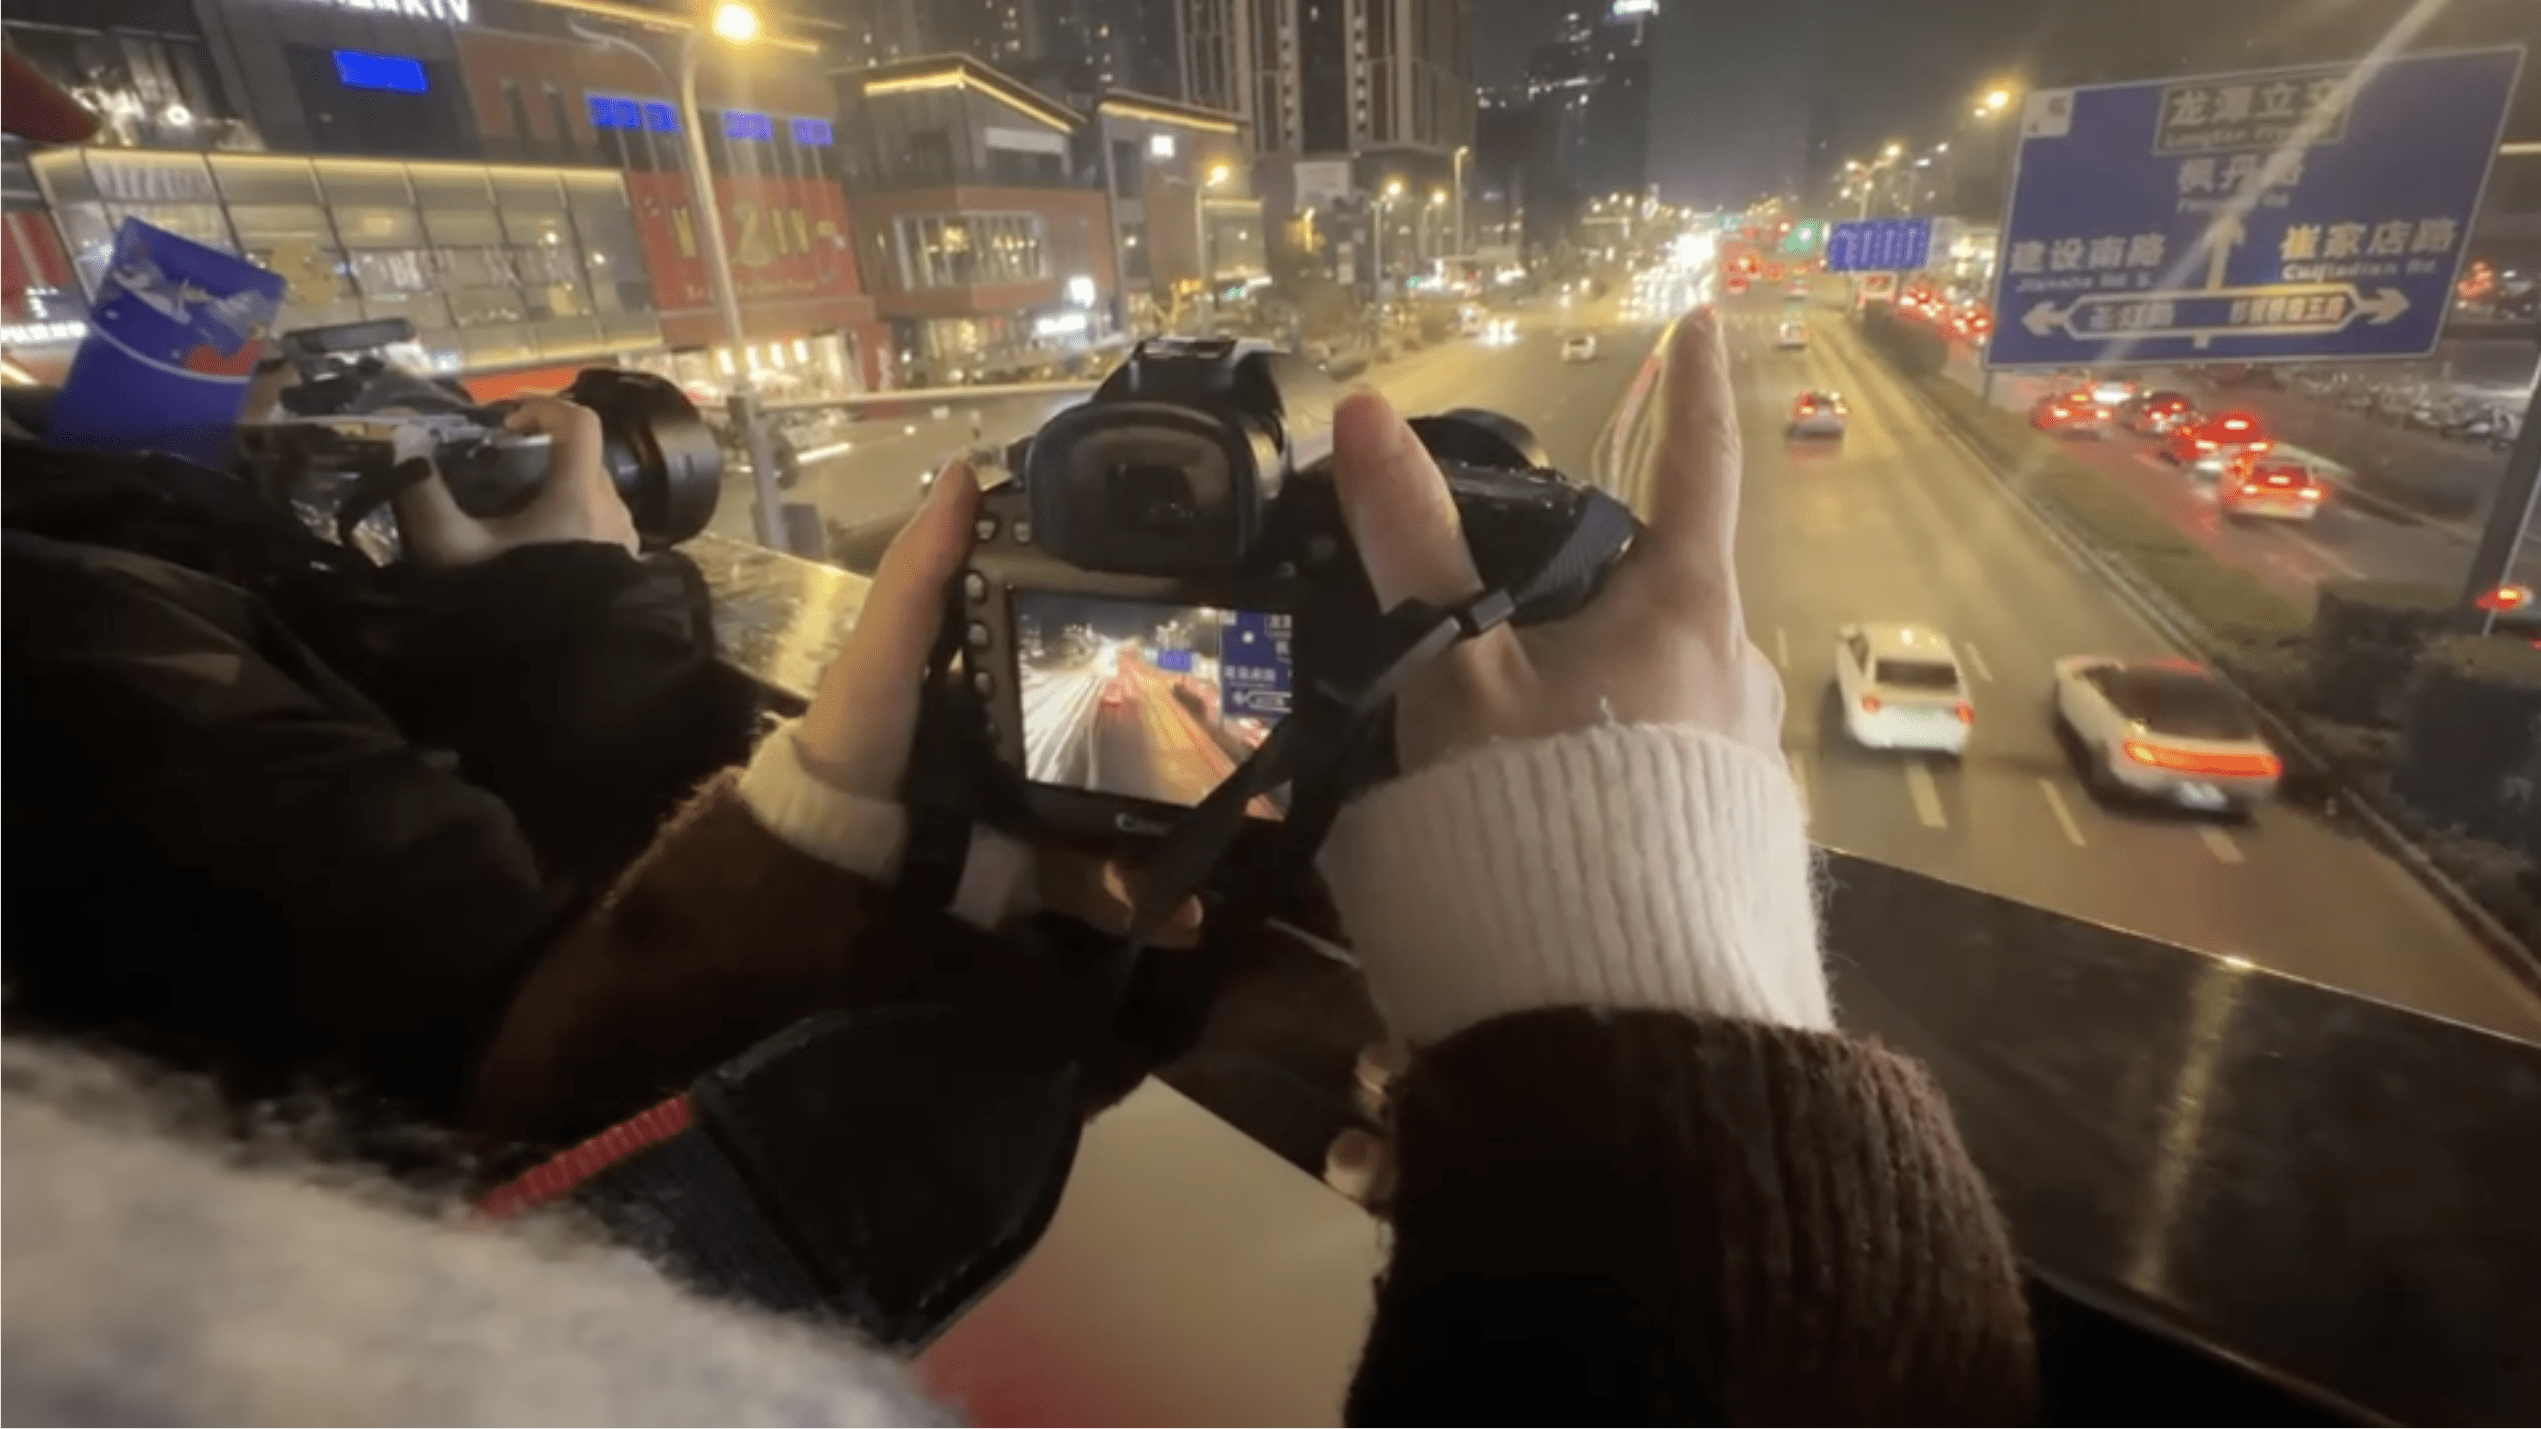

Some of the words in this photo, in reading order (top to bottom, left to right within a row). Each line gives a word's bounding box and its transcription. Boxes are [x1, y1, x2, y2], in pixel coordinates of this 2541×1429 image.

[2009, 231, 2166, 274] 建设南路
[2280, 217, 2456, 261] 崔家店路
